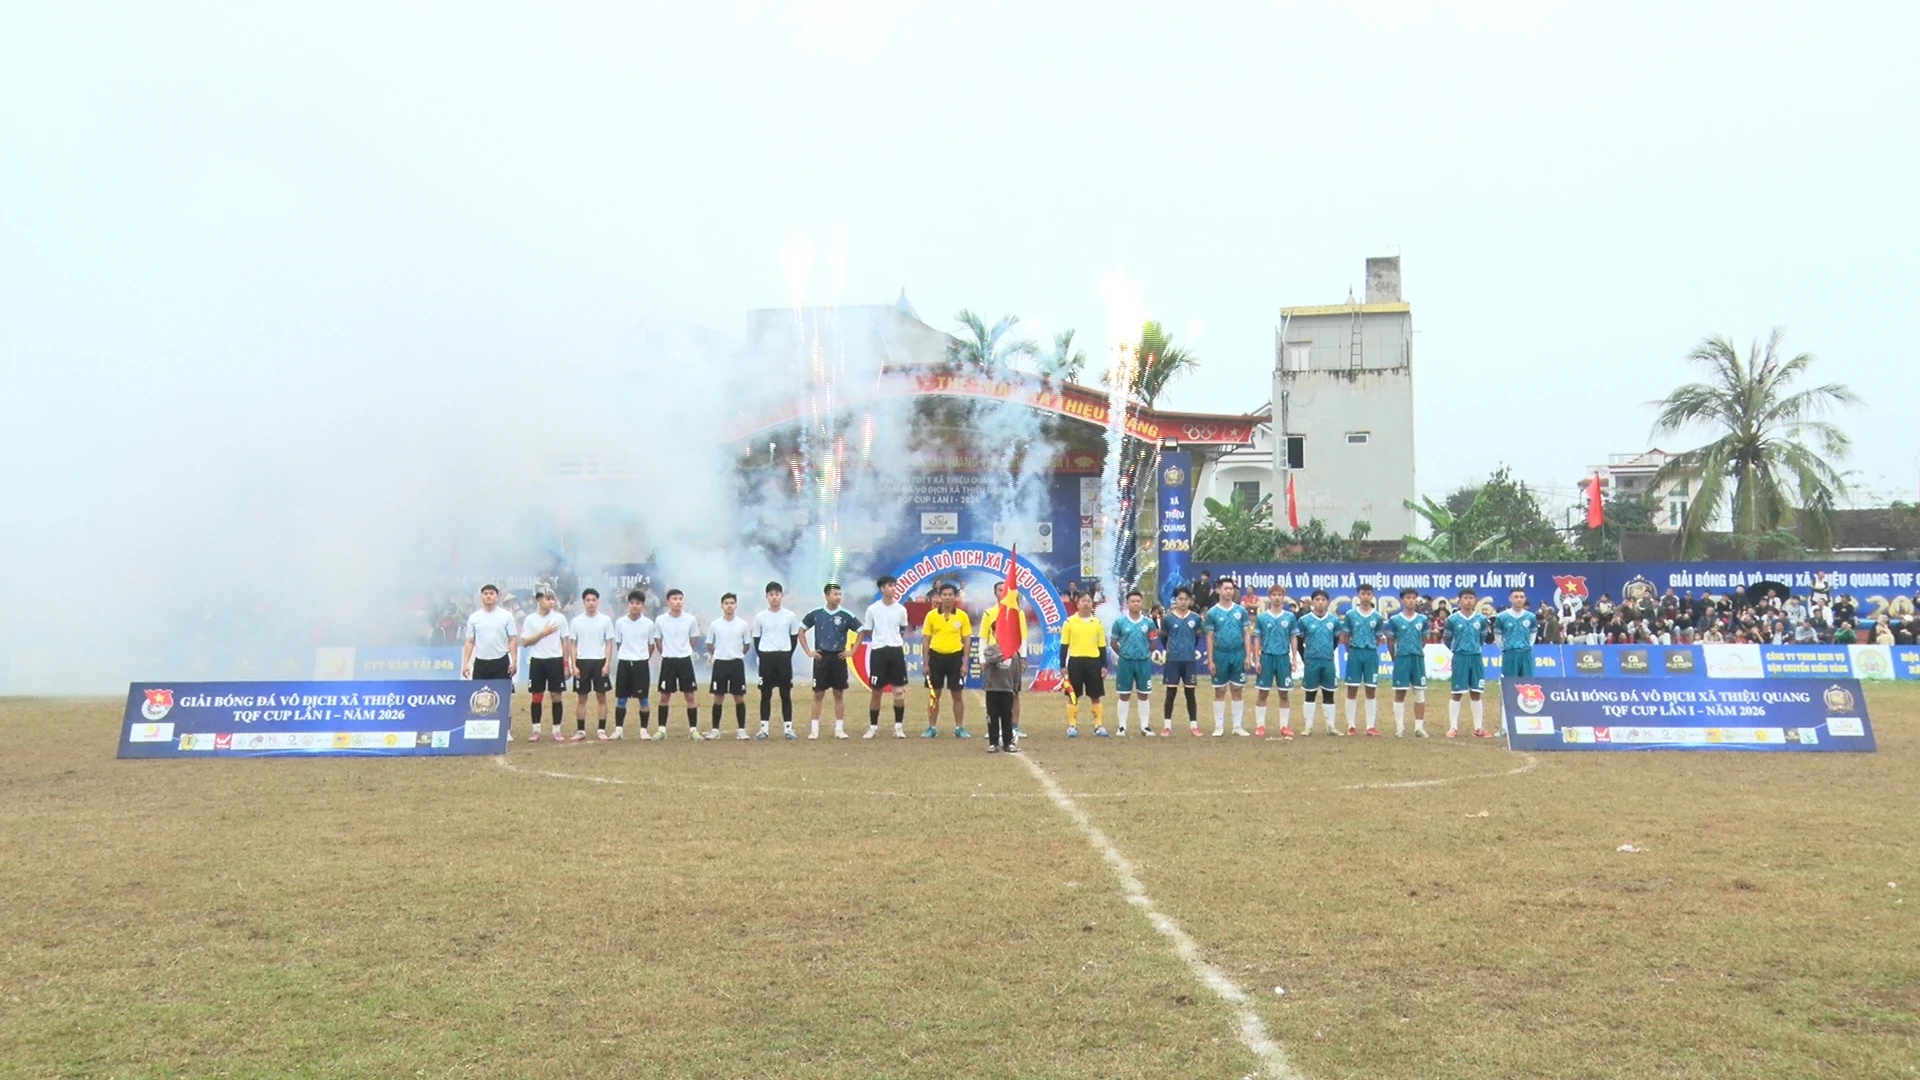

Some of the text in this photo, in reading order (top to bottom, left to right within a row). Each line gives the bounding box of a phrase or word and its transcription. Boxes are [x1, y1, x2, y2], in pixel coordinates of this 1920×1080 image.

[1169, 496, 1180, 505] XÃ
[1163, 525, 1187, 533] QUANG
[1161, 539, 1190, 551] 2026
[1244, 572, 1274, 588] BÓNG
[1295, 572, 1310, 588] VÔ
[1312, 574, 1339, 590] ĐỊCH
[1341, 572, 1357, 588] XÃ
[1359, 572, 1391, 591] THIỆU
[1392, 574, 1430, 589] QUANG
[1432, 574, 1453, 589] TQF
[1454, 574, 1477, 588] CUP
[1479, 570, 1502, 588] LẦN
[1504, 571, 1527, 588] THỨ
[1528, 574, 1535, 588] 1
[1669, 570, 1693, 587] GIẢI
[1695, 571, 1727, 587] BÓNG
[1729, 571, 1745, 587] ĐÁ
[1747, 571, 1763, 587] VÔ
[1795, 571, 1811, 587] XÃ
[1849, 573, 1890, 588] QUANG
[1892, 573, 1914, 588] TQF
[934, 551, 953, 573] VÔ
[985, 552, 1004, 572] XÃ
[1030, 583, 1061, 625] QUANG
[433, 659, 454, 670] 24h
[1535, 657, 1556, 667] 24h
[180, 692, 456, 708] GIẢI BÓNG ĐÁ VÔ ĐỊCH XÃ THIỆU QUANG
[1550, 688, 1810, 704] GIẢI BÓNG ĐÁ VÔ ĐỊCH XÃ THIỆU QUANG
[233, 710, 261, 723] TQF
[263, 710, 292, 721] CUP
[294, 706, 323, 721] LẦN
[325, 710, 331, 720] I
[343, 708, 375, 720] NĂM
[377, 709, 405, 720] 2026
[1602, 705, 1629, 717] TQF
[1631, 705, 1657, 716] CUP
[1660, 702, 1687, 716] LẦN
[1689, 705, 1695, 716] I
[1706, 703, 1737, 716] NĂM
[1739, 705, 1766, 716] 2026
